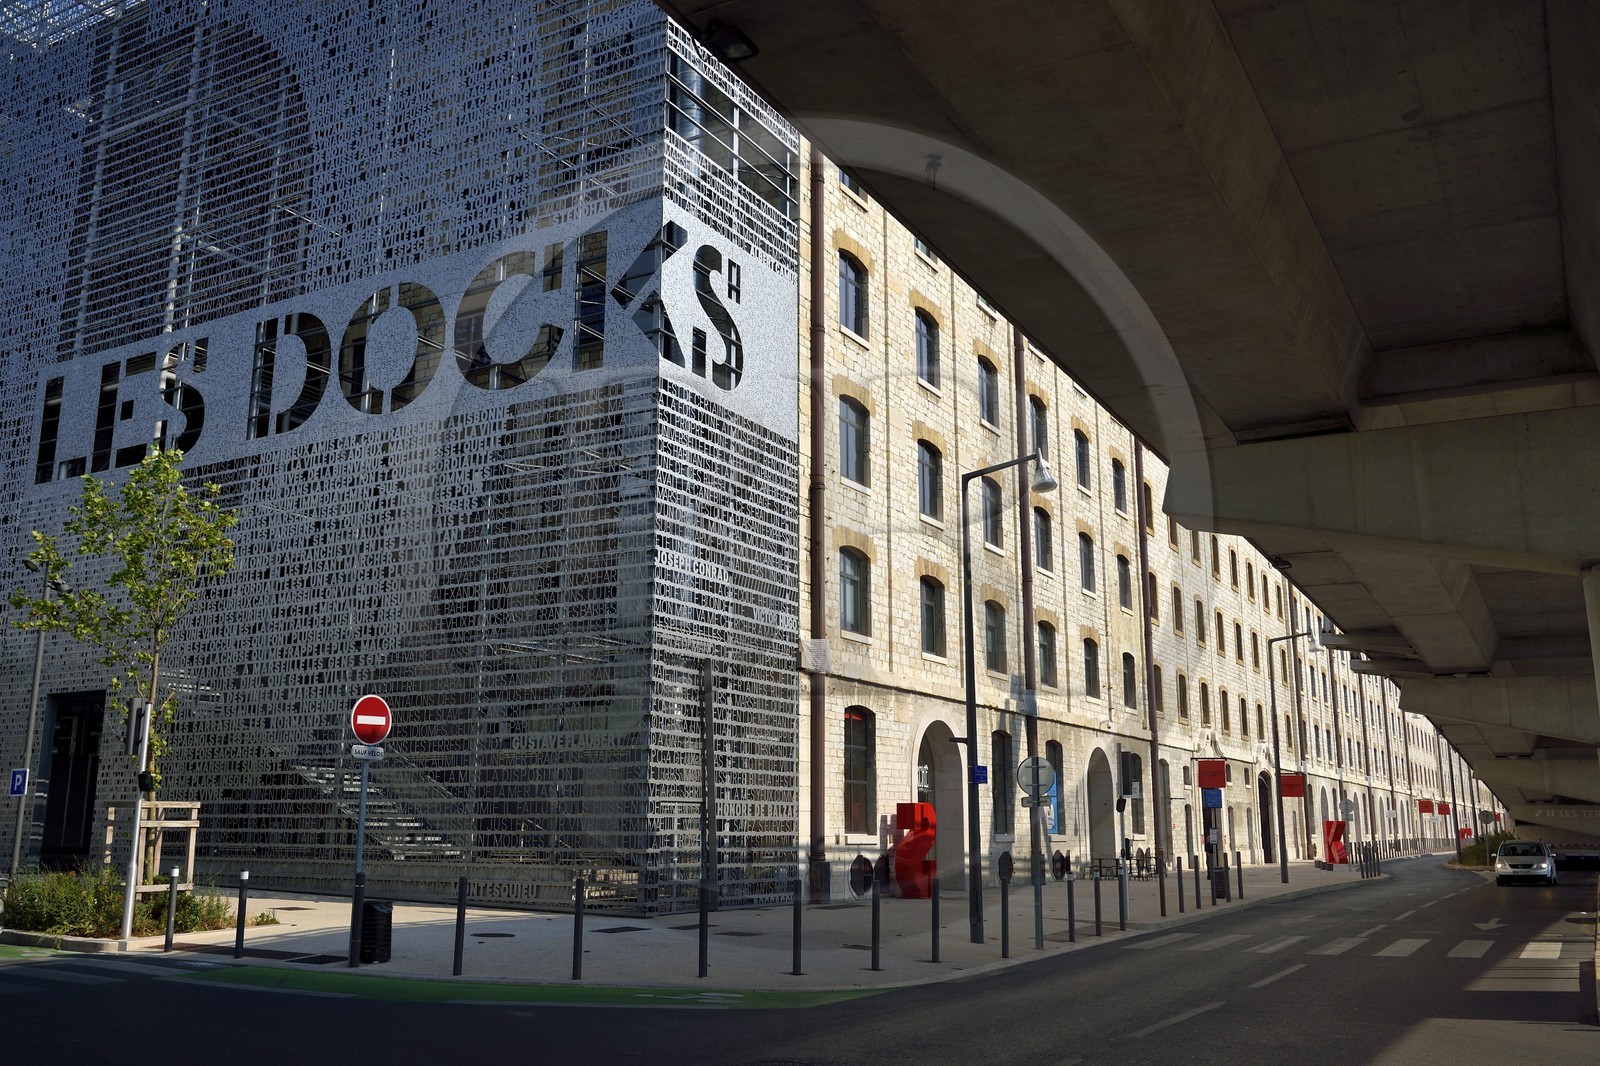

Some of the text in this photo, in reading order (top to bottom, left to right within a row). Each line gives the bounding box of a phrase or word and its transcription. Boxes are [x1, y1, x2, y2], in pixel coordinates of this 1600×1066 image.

[35, 220, 744, 484] LES DOCKS
[354, 748, 367, 756] SAUF
[14, 774, 22, 791] P
